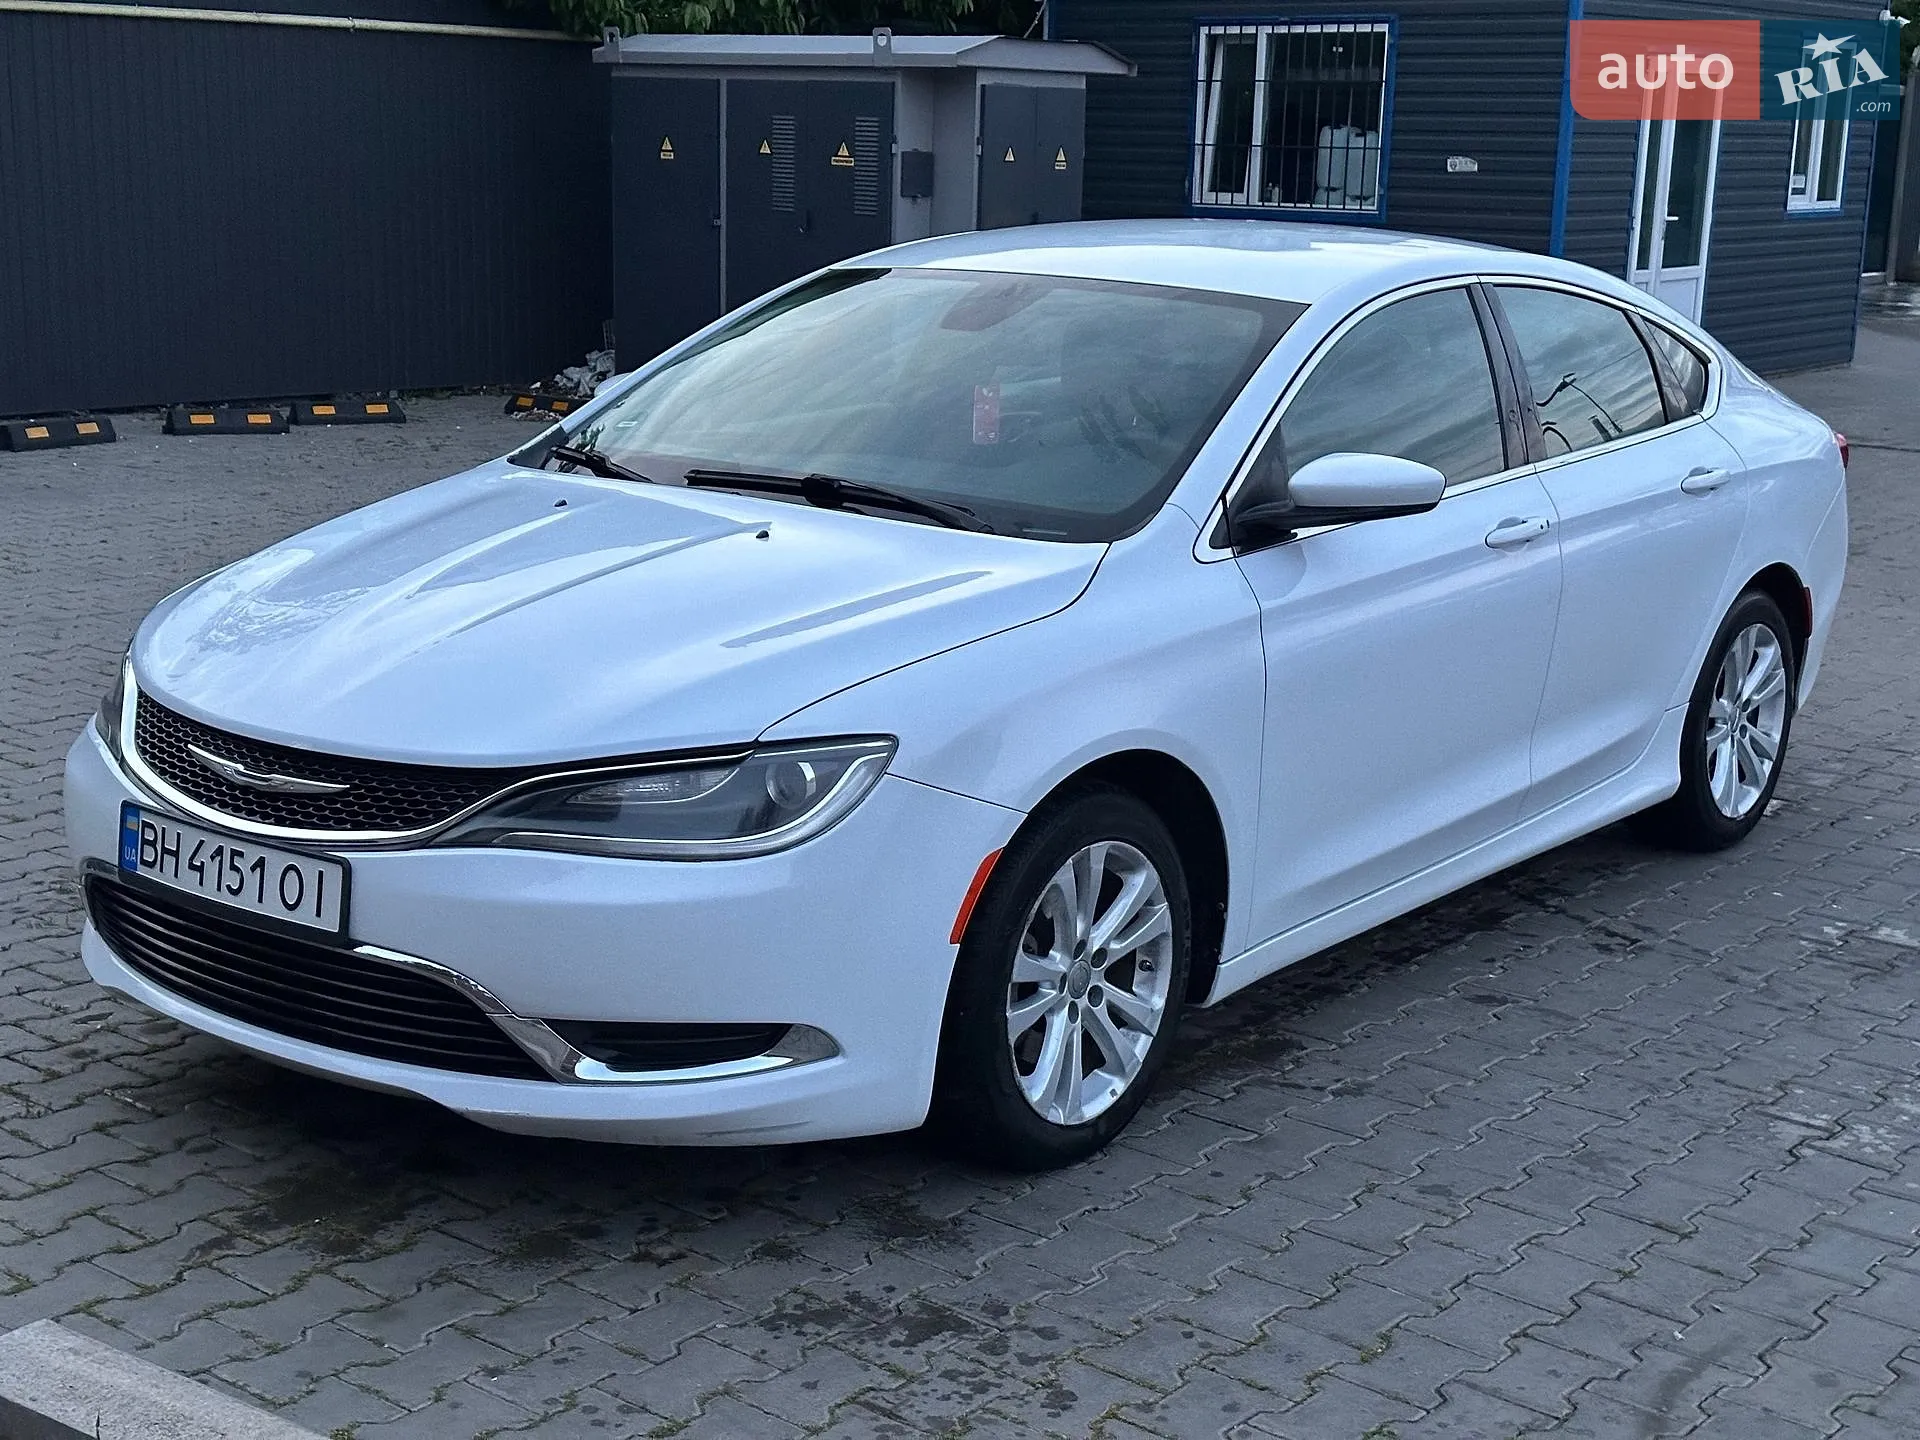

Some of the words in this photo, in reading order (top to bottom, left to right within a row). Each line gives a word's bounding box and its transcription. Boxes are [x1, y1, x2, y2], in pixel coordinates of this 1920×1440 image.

[124, 845, 137, 863] UA
[139, 819, 181, 878] BH
[187, 838, 266, 904] 4151
[279, 863, 324, 918] OI
